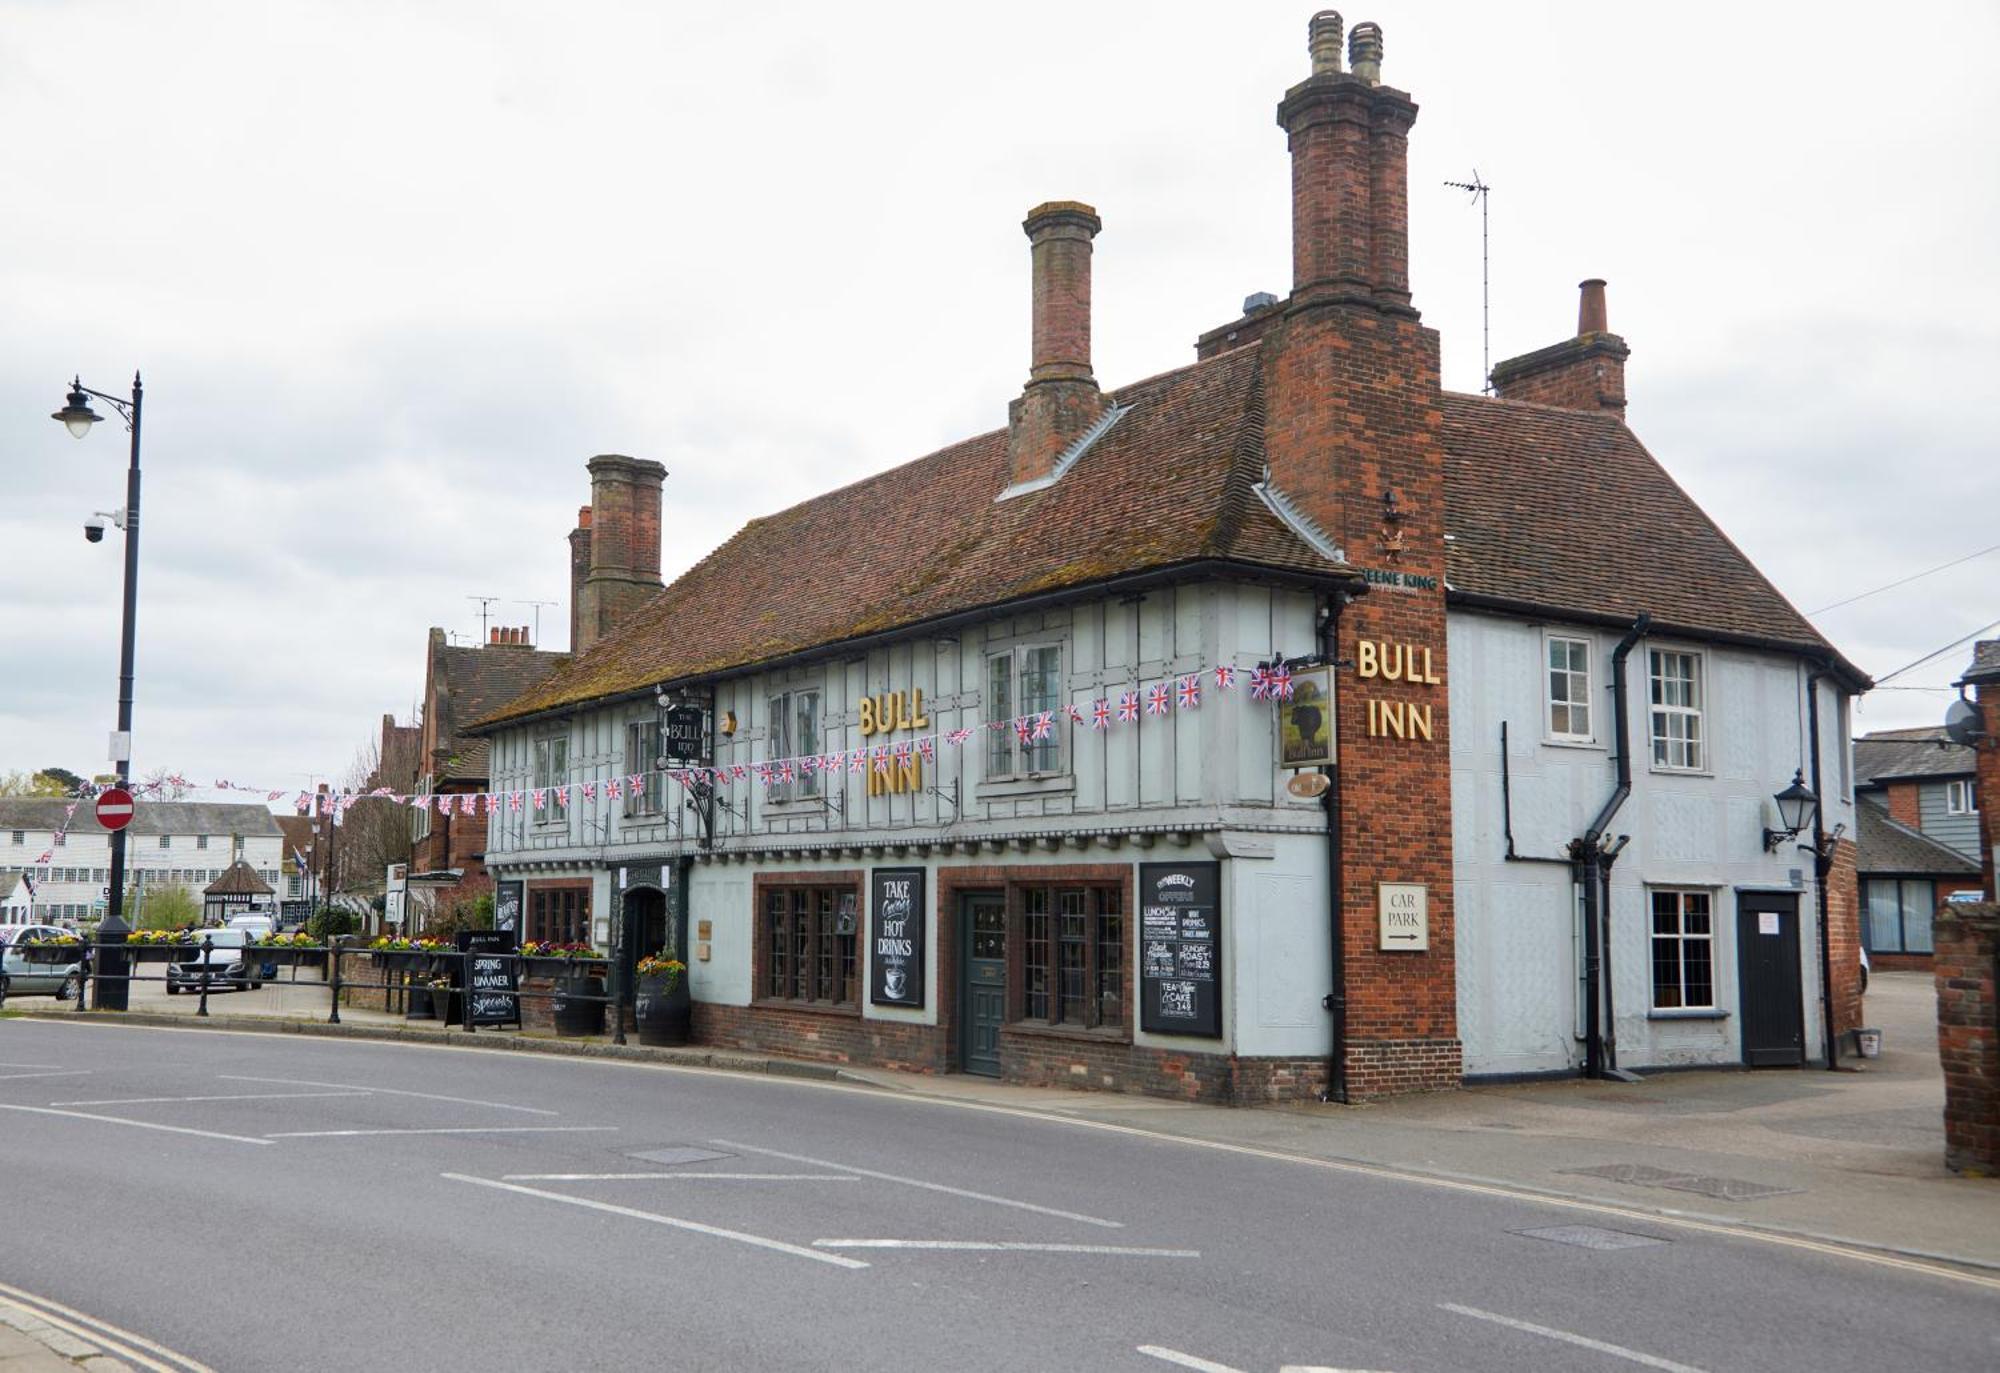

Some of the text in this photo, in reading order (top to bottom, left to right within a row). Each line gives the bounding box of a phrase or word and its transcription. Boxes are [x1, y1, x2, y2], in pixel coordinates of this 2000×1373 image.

[1404, 574, 1438, 590] KING
[1358, 640, 1440, 685] BULL
[859, 687, 929, 736] BULL
[1369, 699, 1432, 741] INN
[671, 724, 701, 739] BULL
[867, 751, 922, 797] INN
[1166, 874, 1195, 888] WEEKLY
[884, 881, 911, 899] TAKE
[1391, 894, 1415, 908] CAR
[1388, 912, 1419, 926] PARK
[884, 920, 905, 937] HOT
[878, 938, 912, 956] DRINKS
[474, 959, 502, 970] SPRING
[473, 993, 513, 1016] Specials
